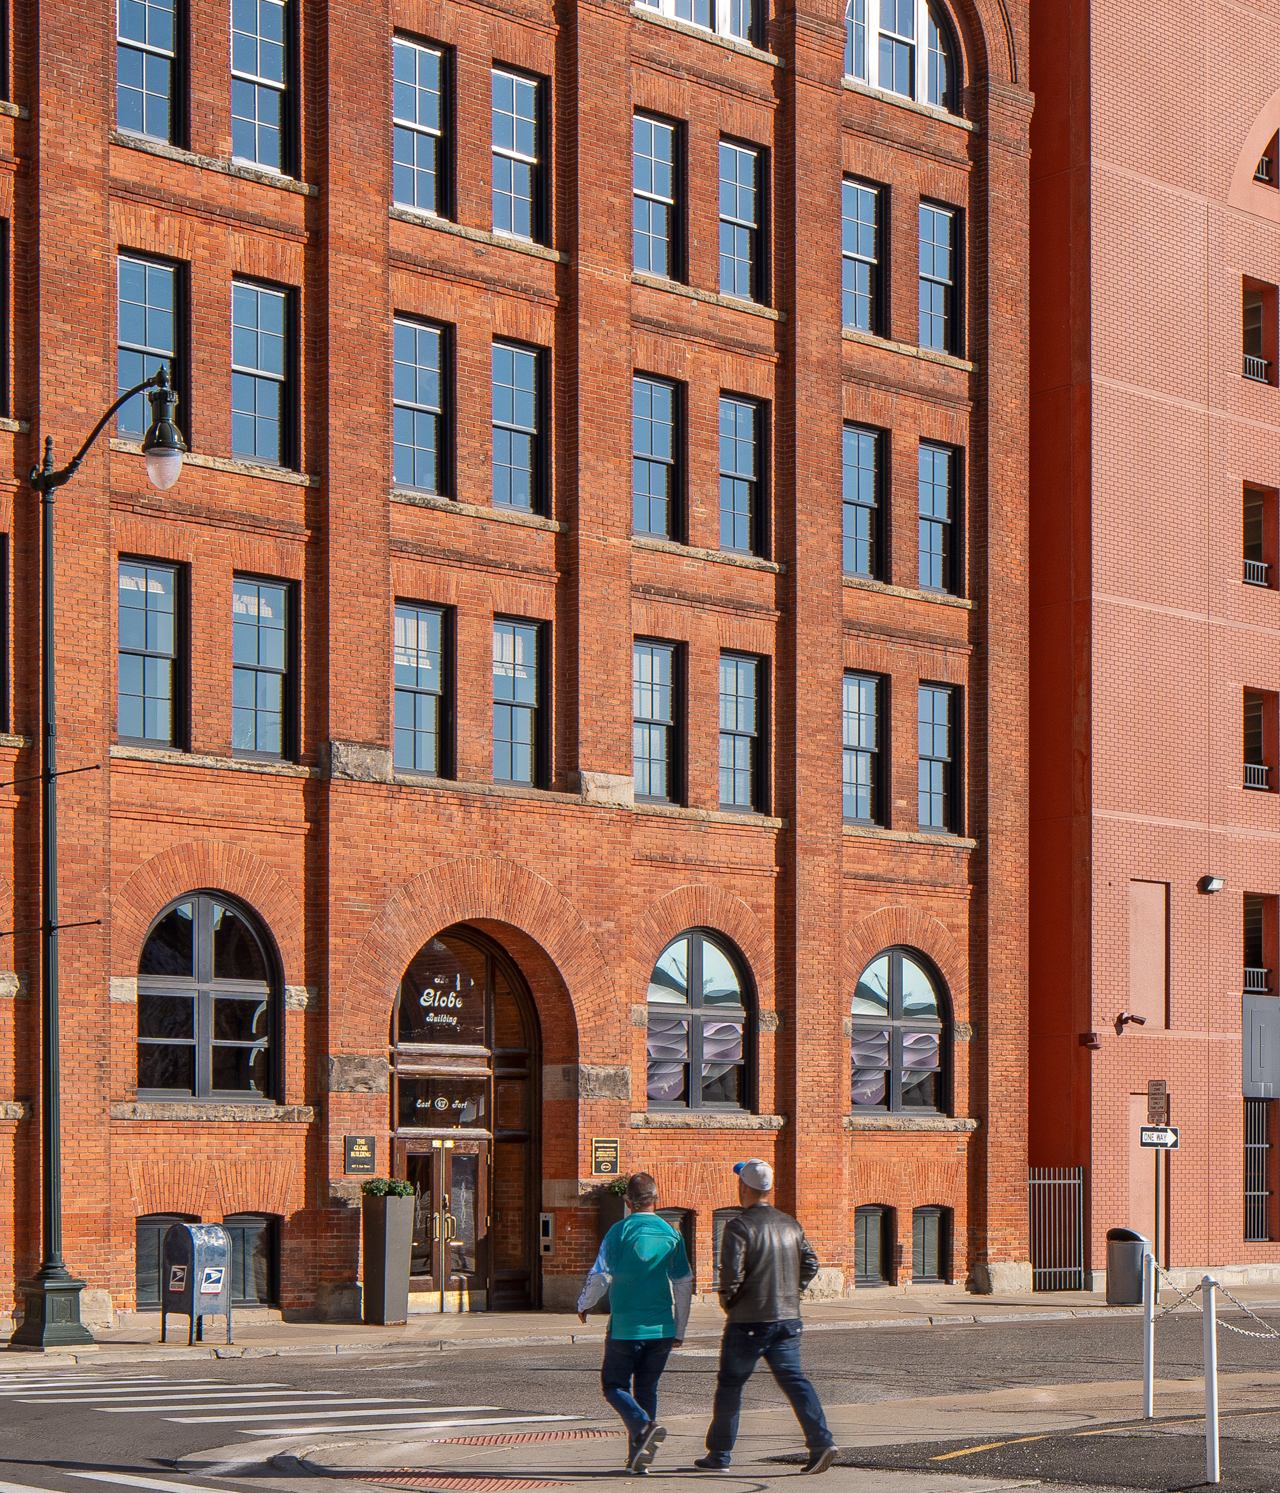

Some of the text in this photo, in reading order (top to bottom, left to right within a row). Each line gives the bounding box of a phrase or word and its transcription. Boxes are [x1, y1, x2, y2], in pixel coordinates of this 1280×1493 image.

[420, 988, 463, 1008] Globe
[426, 1012, 458, 1026] Building
[416, 1099, 431, 1108] East
[452, 1100, 468, 1109] Fort
[1143, 1132, 1168, 1142] ONE WAY
